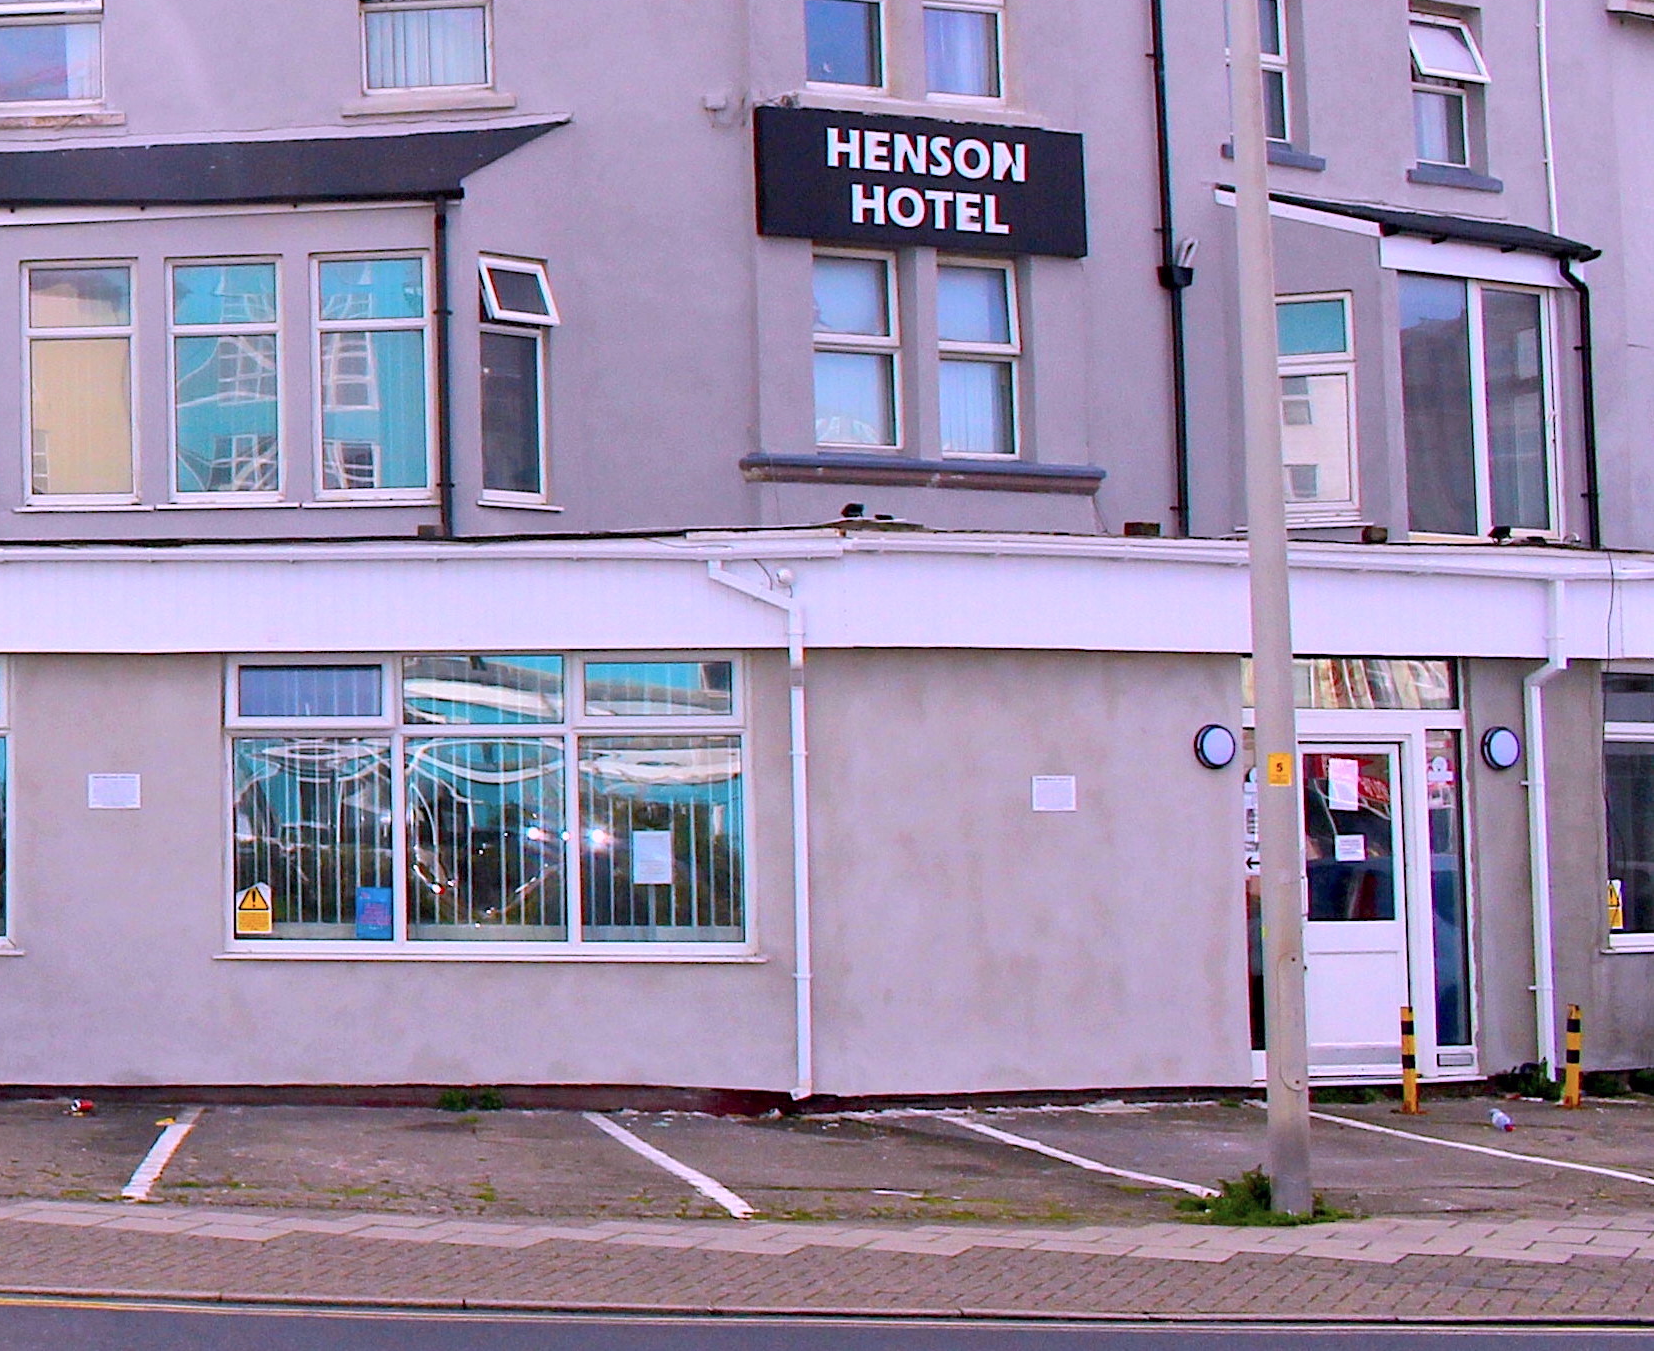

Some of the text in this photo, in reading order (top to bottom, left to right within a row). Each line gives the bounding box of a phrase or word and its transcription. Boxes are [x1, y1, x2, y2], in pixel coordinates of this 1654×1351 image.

[826, 127, 1027, 182] HENSON
[851, 183, 1010, 235] HOTEL
[1276, 762, 1283, 772] 5
